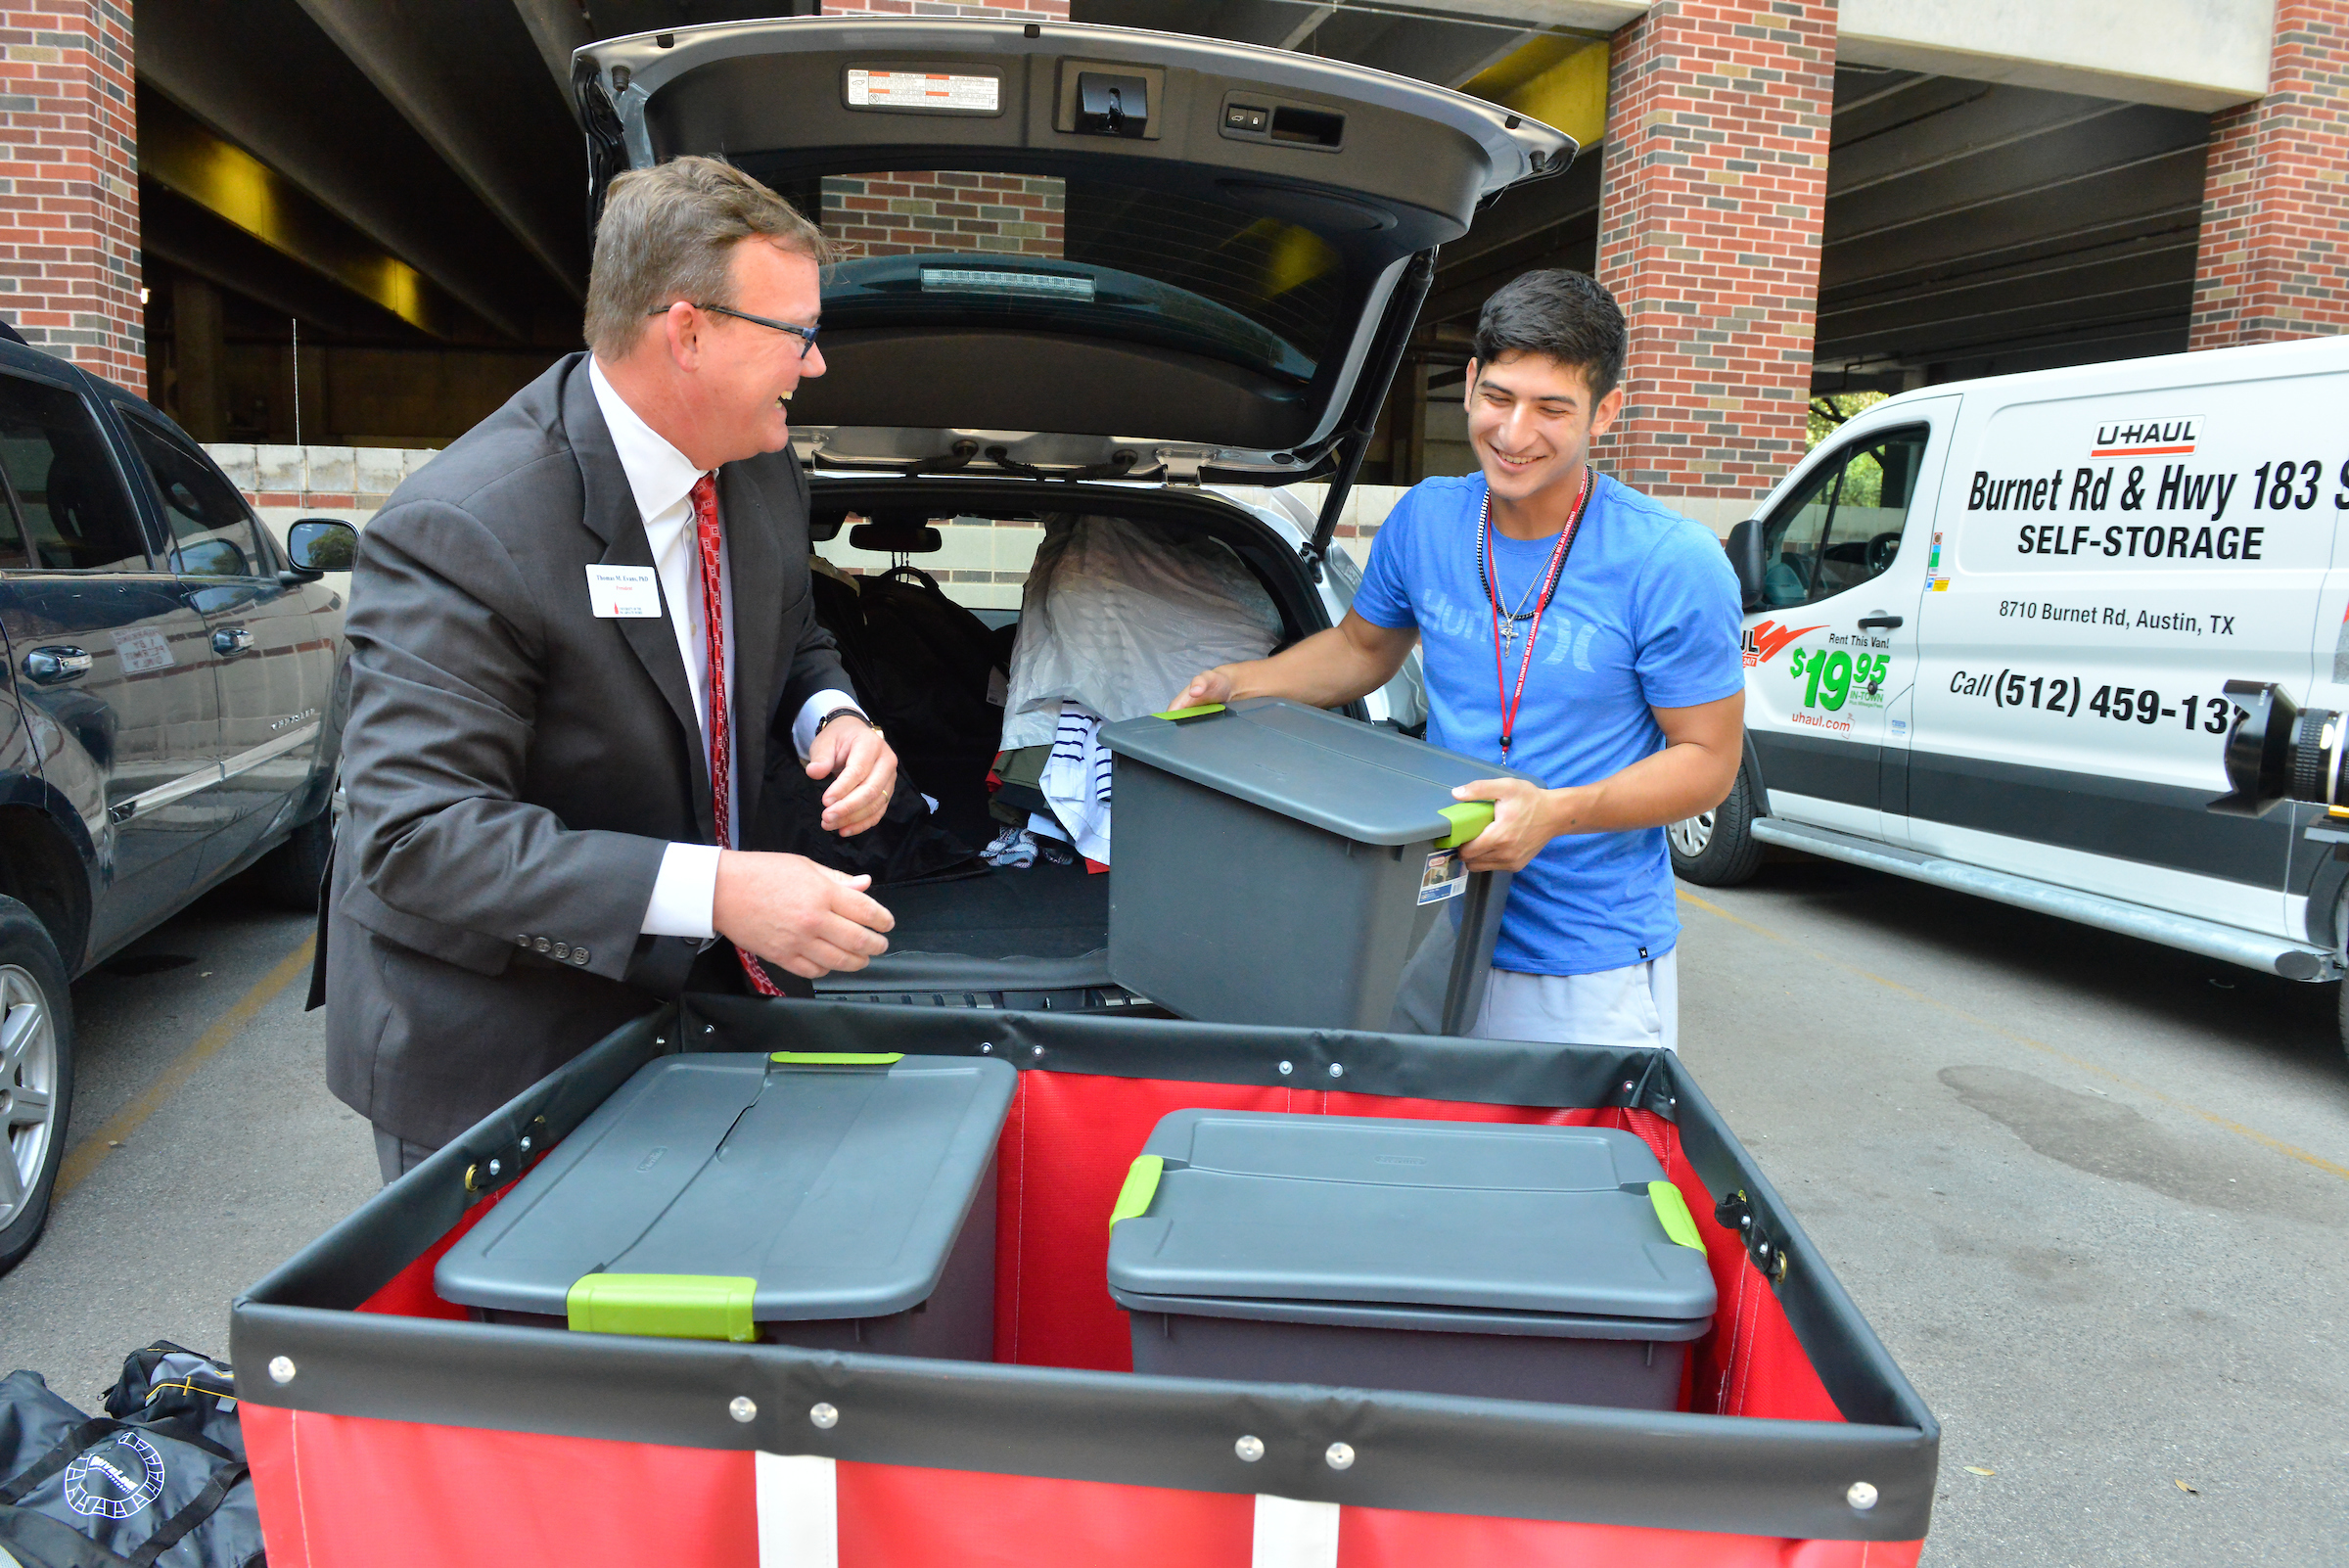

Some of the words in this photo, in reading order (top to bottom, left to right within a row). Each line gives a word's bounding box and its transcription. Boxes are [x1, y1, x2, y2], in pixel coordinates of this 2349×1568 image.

[2096, 421, 2196, 445] U-HAUL
[1967, 470, 2062, 511] Burnet
[2069, 467, 2114, 511] Rd
[2120, 465, 2145, 511] &
[2156, 464, 2238, 521] Hwy
[2253, 460, 2323, 510] 183
[2018, 525, 2265, 560] SELF-STORAGE
[1546, 553, 1560, 578] INCARNATE
[1999, 600, 2037, 619] 8710
[2042, 603, 2097, 623] Burnet
[2102, 607, 2130, 630] Rd,
[2136, 610, 2202, 636] Austin,
[2210, 615, 2235, 635] TX
[1828, 632, 1849, 645] Rent
[1851, 634, 1868, 647] This
[1870, 636, 1890, 649] Van!
[1519, 656, 1529, 681] INCARNATE
[1743, 657, 1756, 666] 24/7
[1850, 690, 1884, 702] IN-TOWN
[1950, 670, 1994, 697] Call
[1995, 669, 2081, 717] (512)
[1792, 713, 1851, 732] uhaul.com
